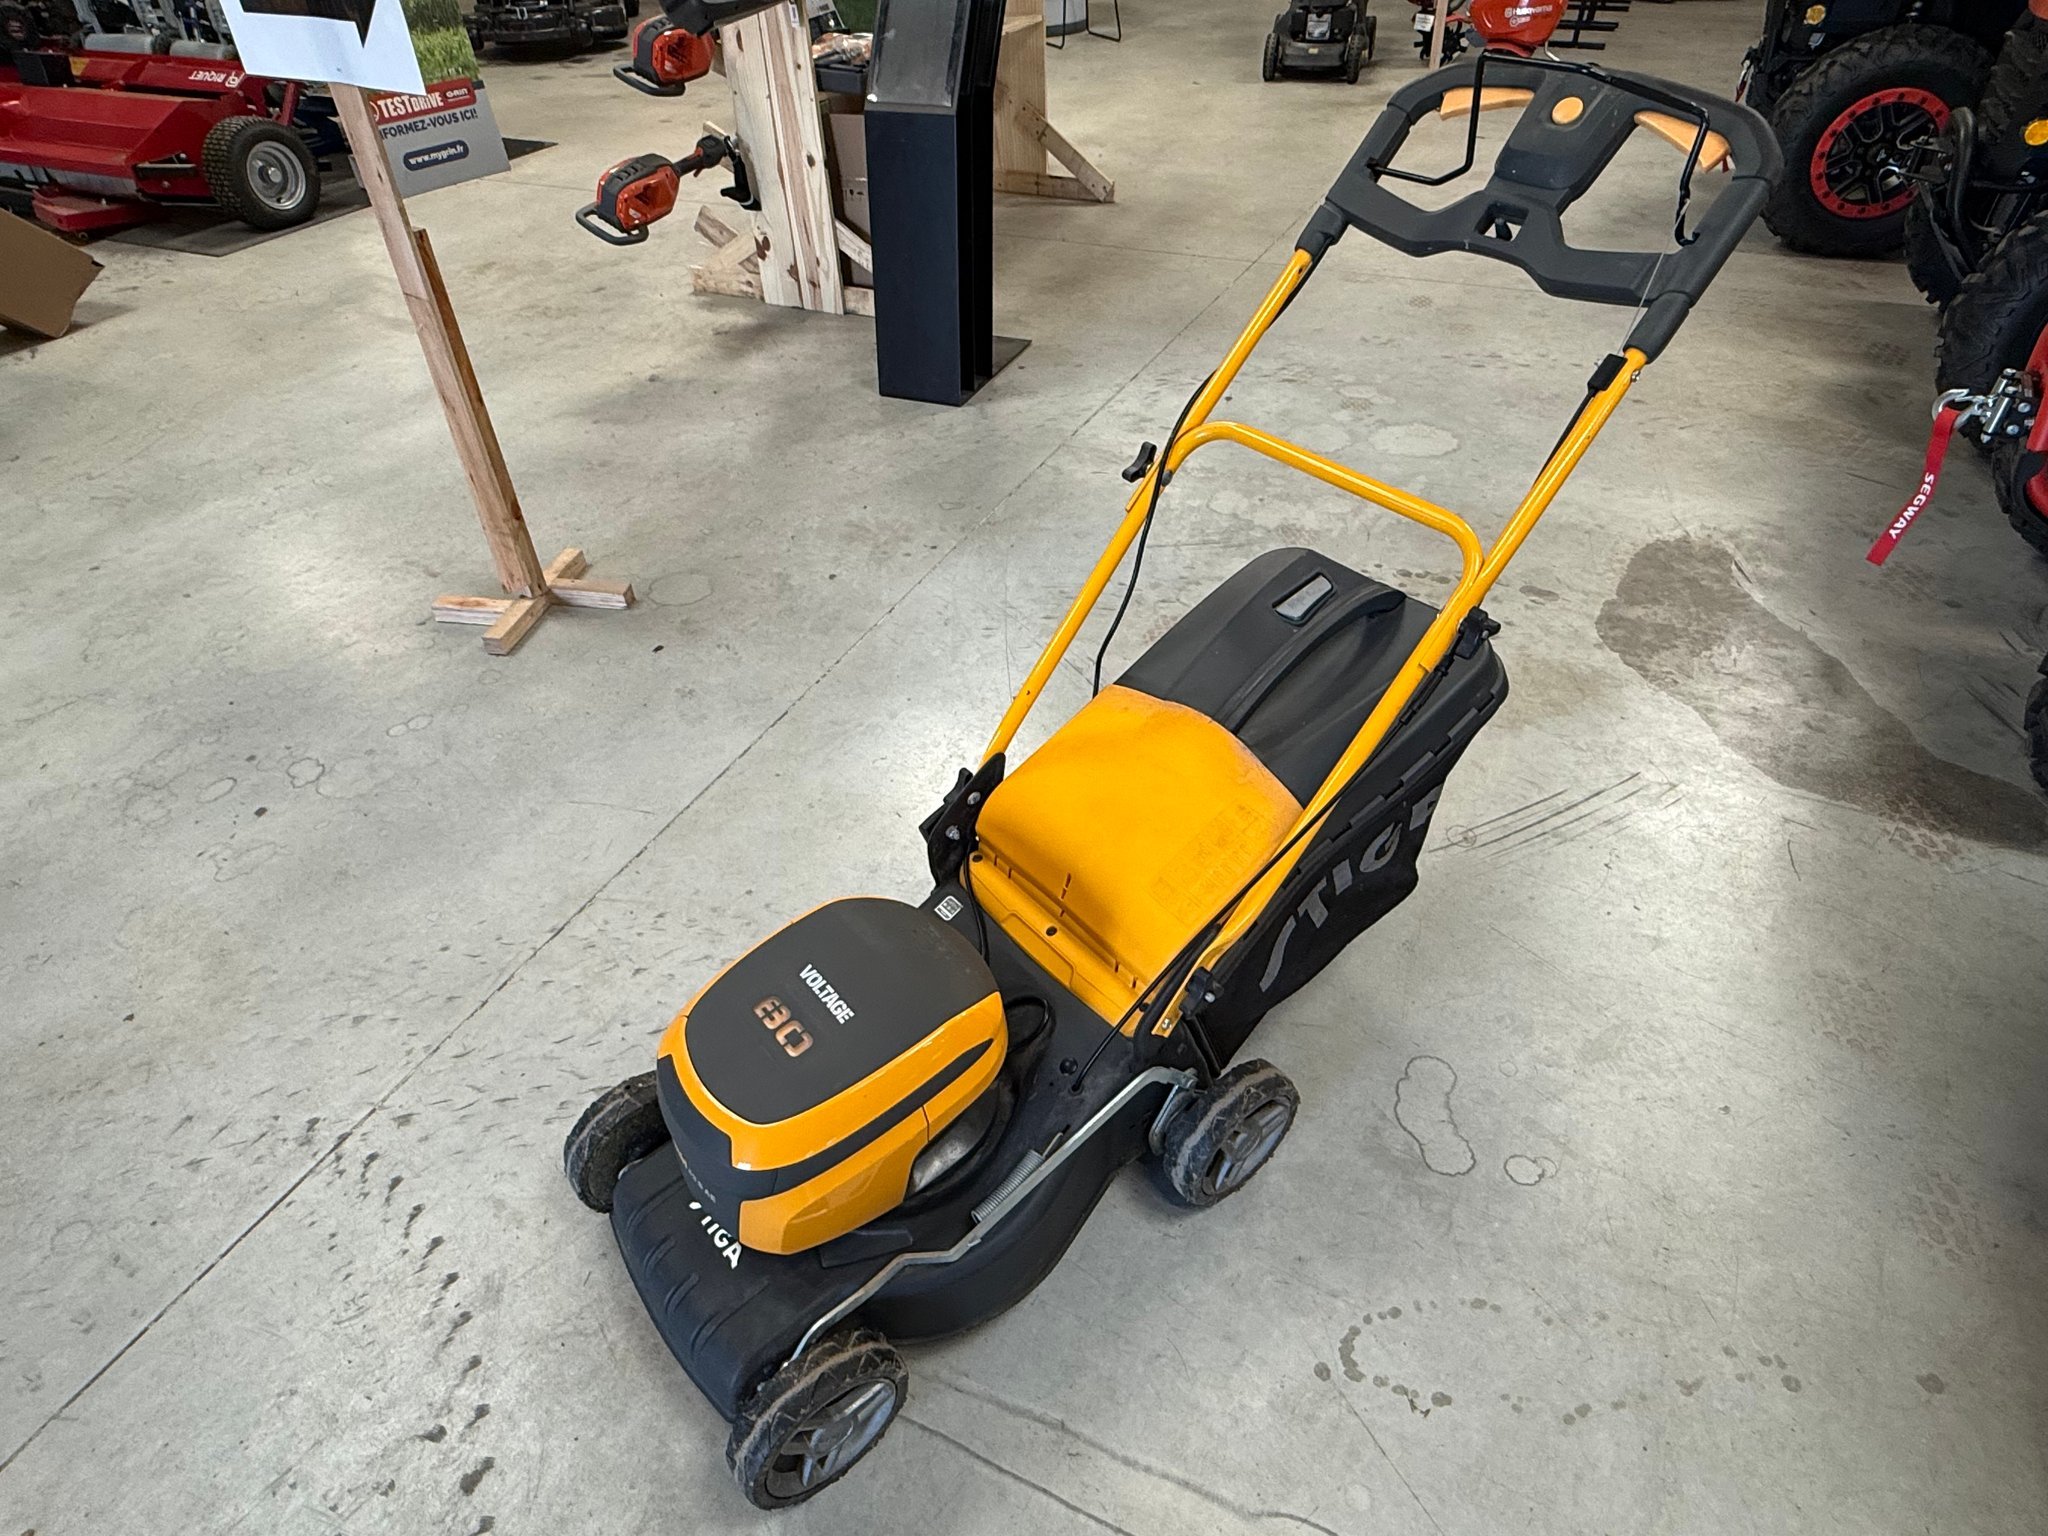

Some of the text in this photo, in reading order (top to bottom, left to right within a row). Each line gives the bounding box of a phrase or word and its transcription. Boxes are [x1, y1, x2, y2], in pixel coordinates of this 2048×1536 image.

[188, 70, 227, 82] RIQUET
[460, 108, 478, 122] ICI!
[408, 144, 464, 165] www.mygrin.fr
[1888, 472, 1935, 539] SEGWAY
[799, 963, 855, 1024] VOLTAGE
